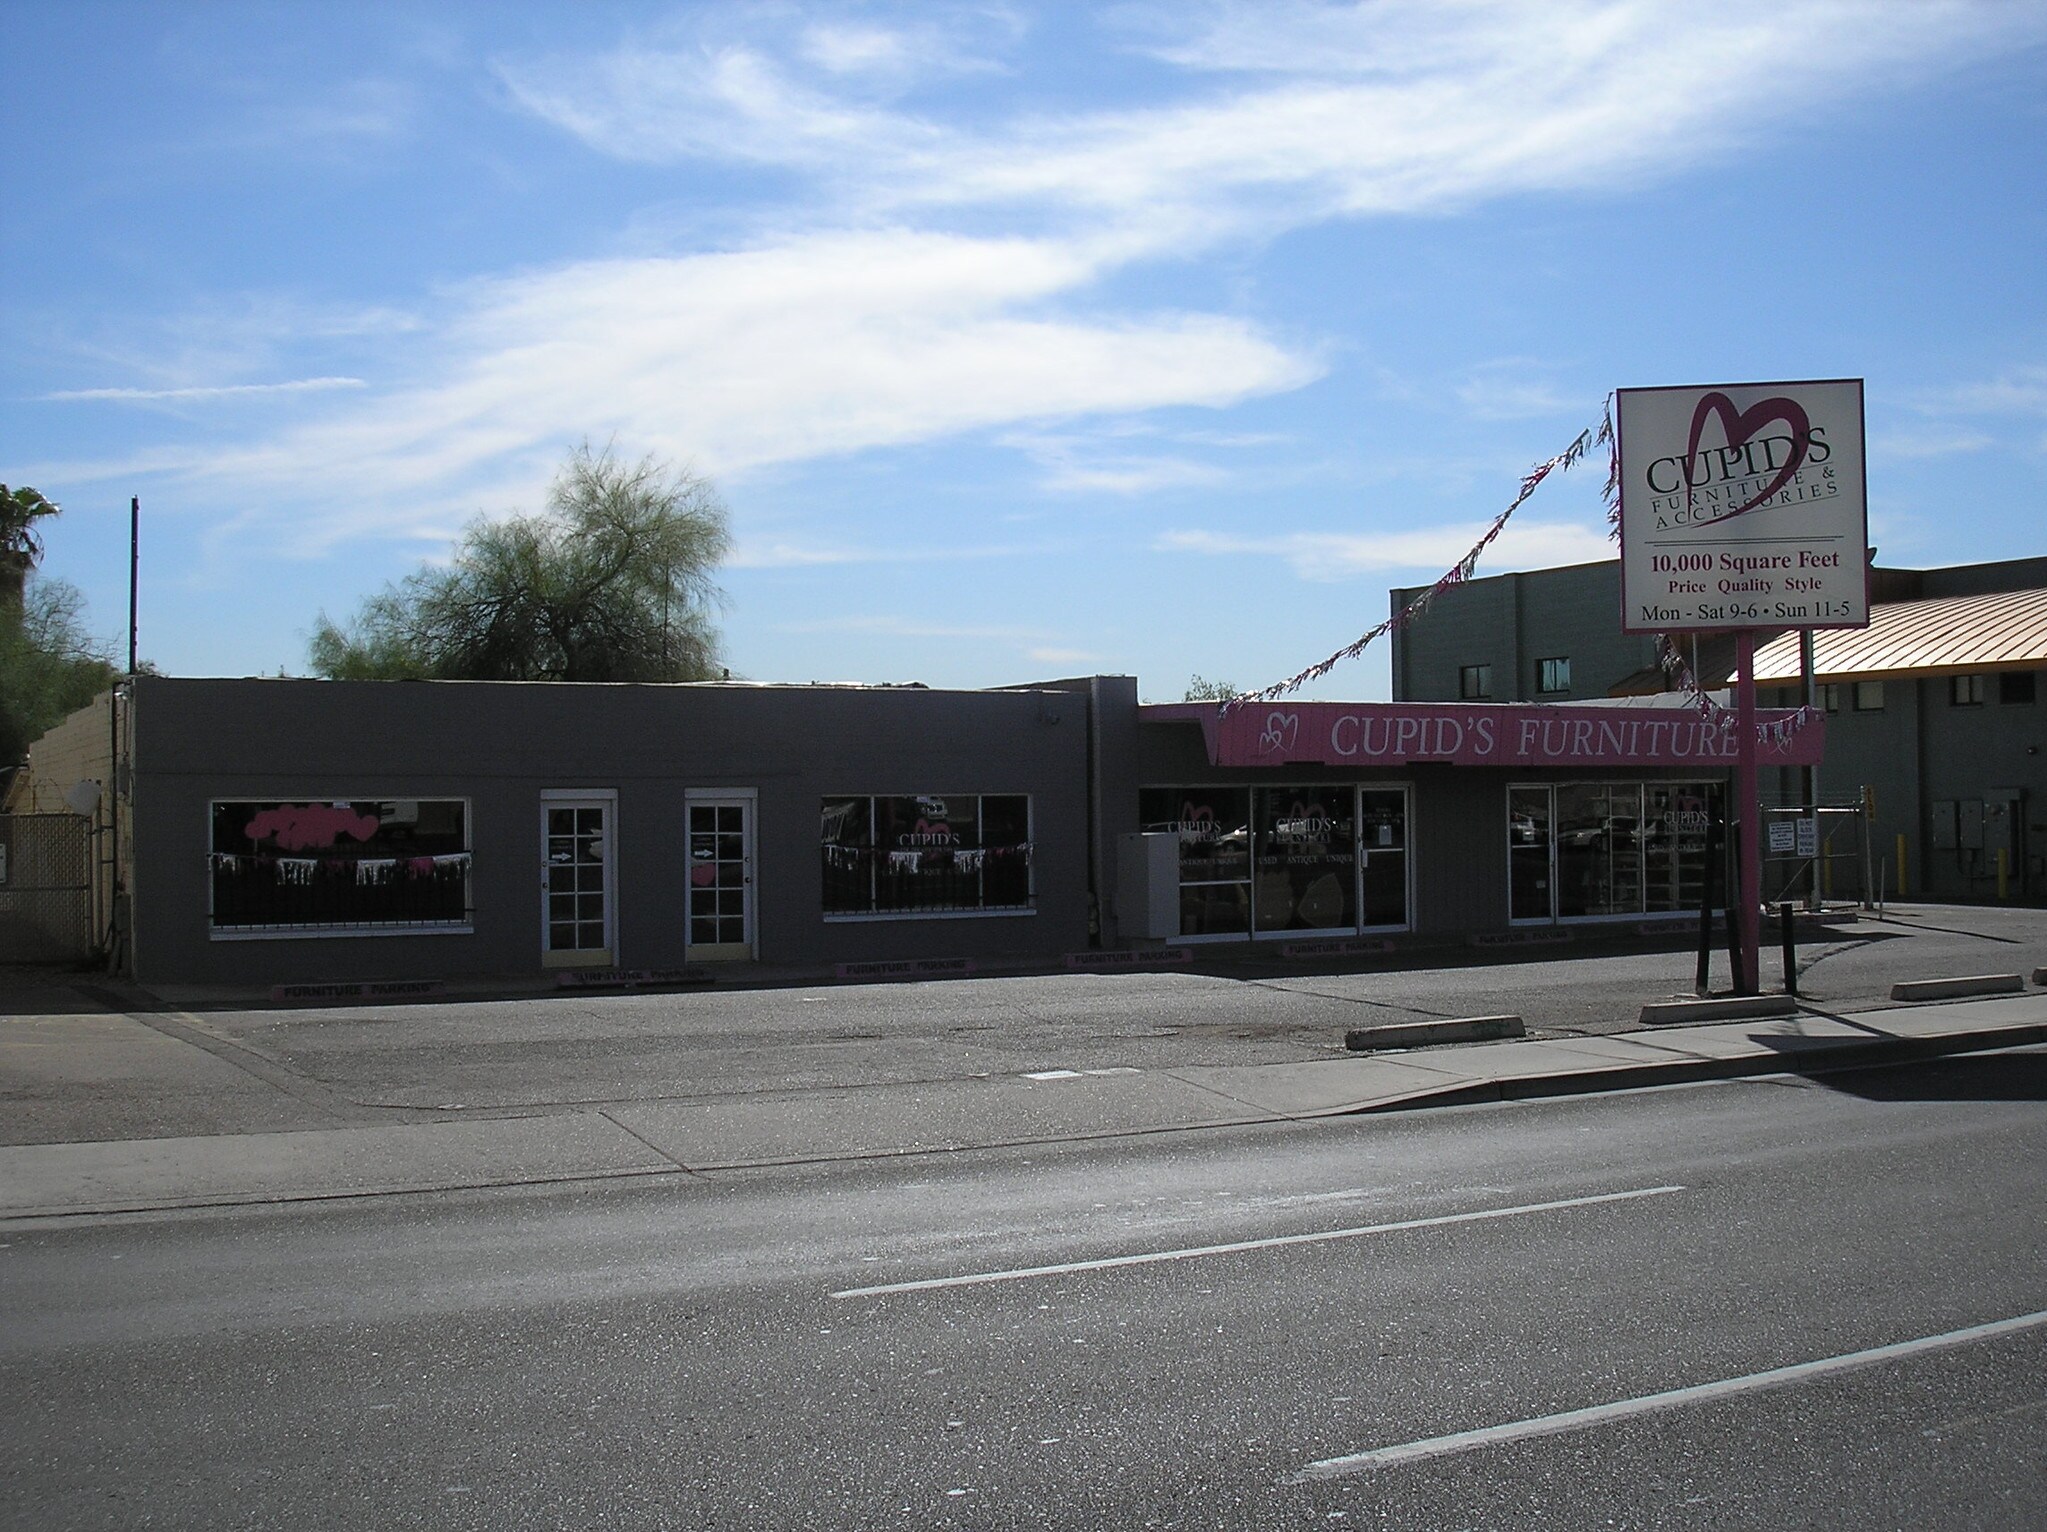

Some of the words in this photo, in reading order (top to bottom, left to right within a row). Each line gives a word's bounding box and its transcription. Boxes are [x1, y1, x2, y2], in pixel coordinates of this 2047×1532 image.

[1652, 471, 1804, 513] FURNITUE
[1822, 466, 1835, 479] &
[1651, 553, 1713, 574] 10,000
[1719, 551, 1792, 575] Square
[1799, 550, 1840, 568] Feet
[1668, 579, 1707, 594] Price
[1717, 578, 1774, 595] Quality
[1784, 576, 1823, 593] Style
[1641, 605, 1680, 622] Mon
[1698, 604, 1725, 620] Sat
[1729, 603, 1758, 619] 9-6
[1774, 602, 1807, 618] Sun
[1814, 600, 1850, 617] 11-5
[1331, 715, 1494, 756] CUPID'S
[1517, 719, 1739, 756] FURNITURE
[1276, 817, 1331, 832] CUPID'S
[1664, 811, 1708, 824] CUPID'S
[1167, 820, 1222, 833] CUPID'S
[899, 833, 960, 846] CUPID'S
[1258, 856, 1278, 864] USED
[1286, 855, 1319, 865] ANTIQUE
[1325, 854, 1354, 864] UNIQUE
[284, 984, 363, 998] FURNITURE
[371, 982, 430, 995] PARKING
